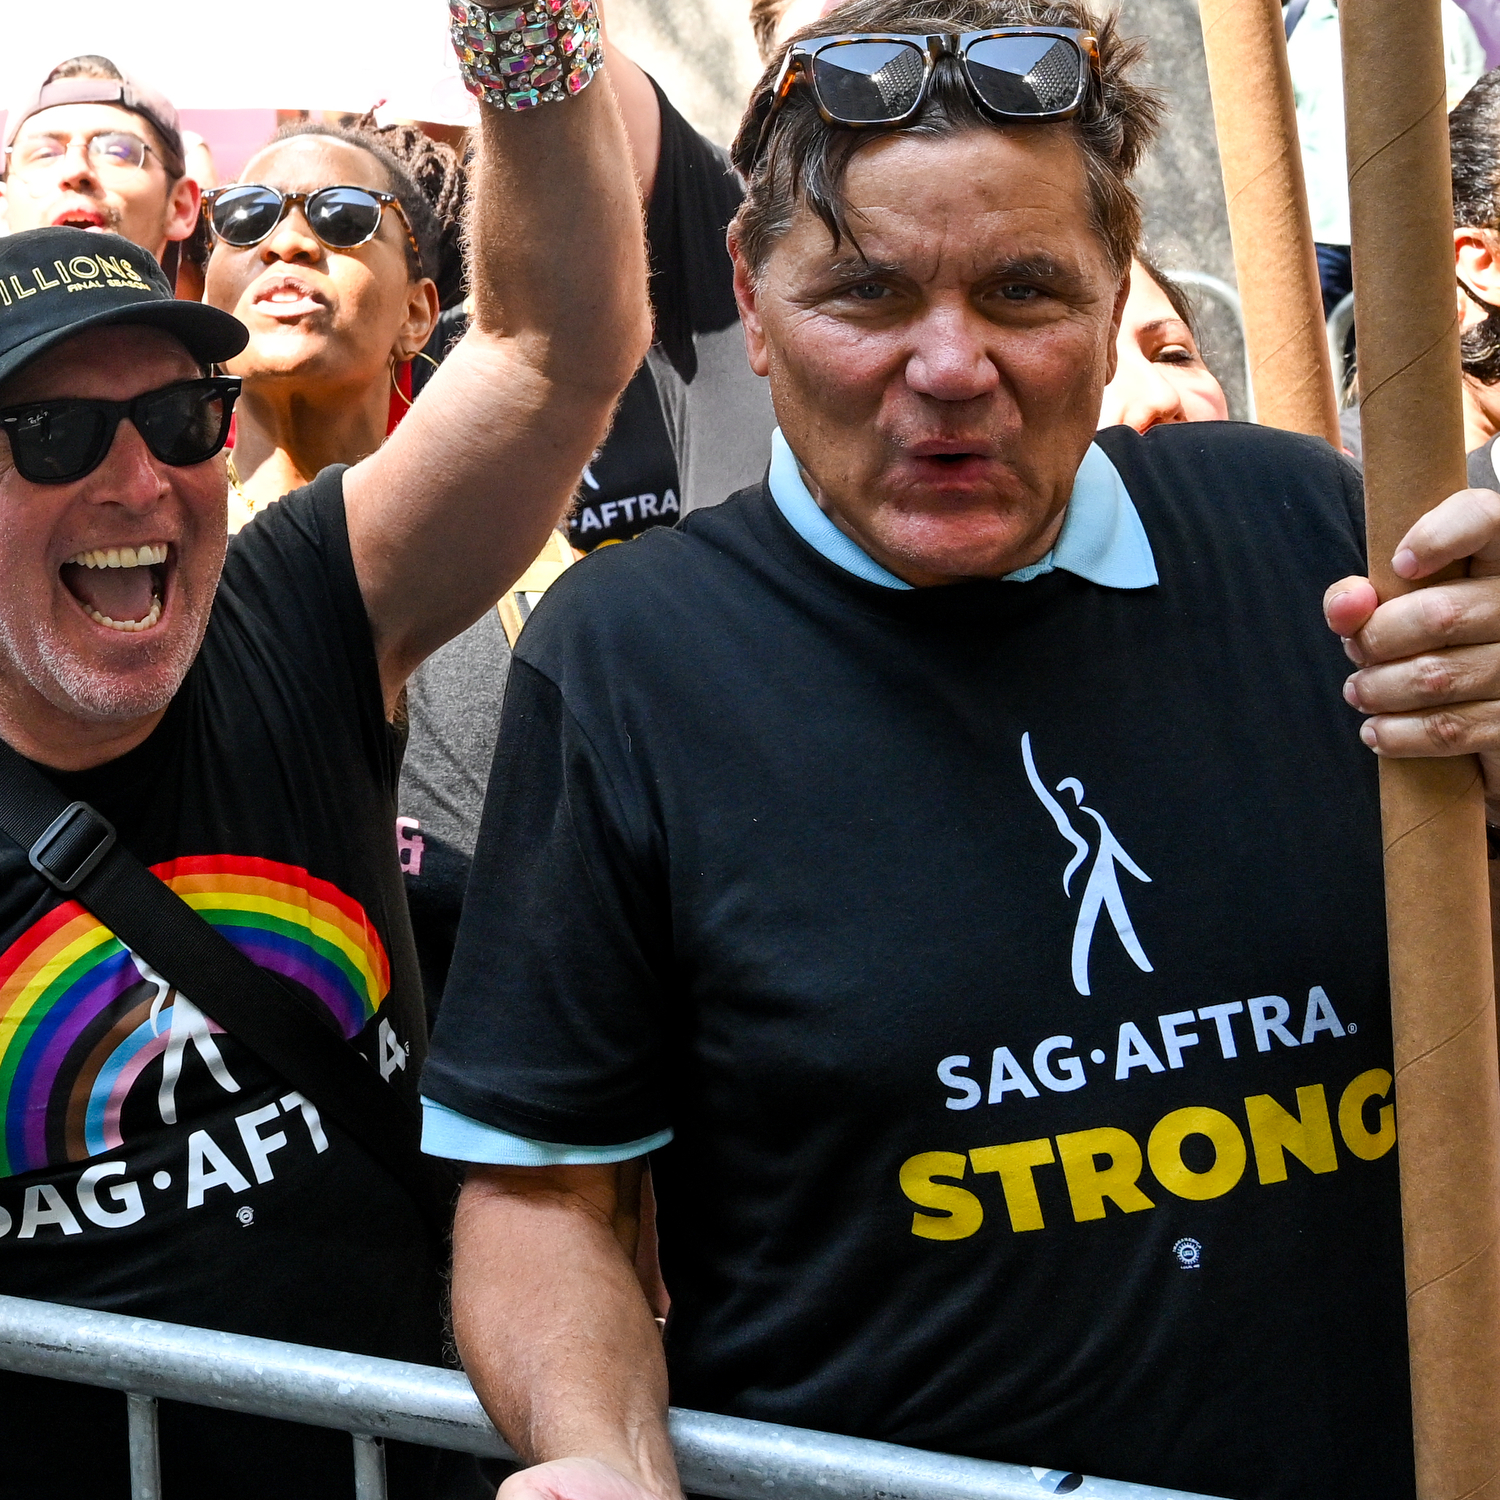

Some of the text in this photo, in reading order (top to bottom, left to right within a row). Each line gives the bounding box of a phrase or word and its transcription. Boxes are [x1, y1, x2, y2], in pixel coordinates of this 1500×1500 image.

[67, 278, 151, 293] FINAL SEASON
[936, 985, 1358, 1111] SAG·AFTRA®
[898, 1068, 1396, 1241] STRONG
